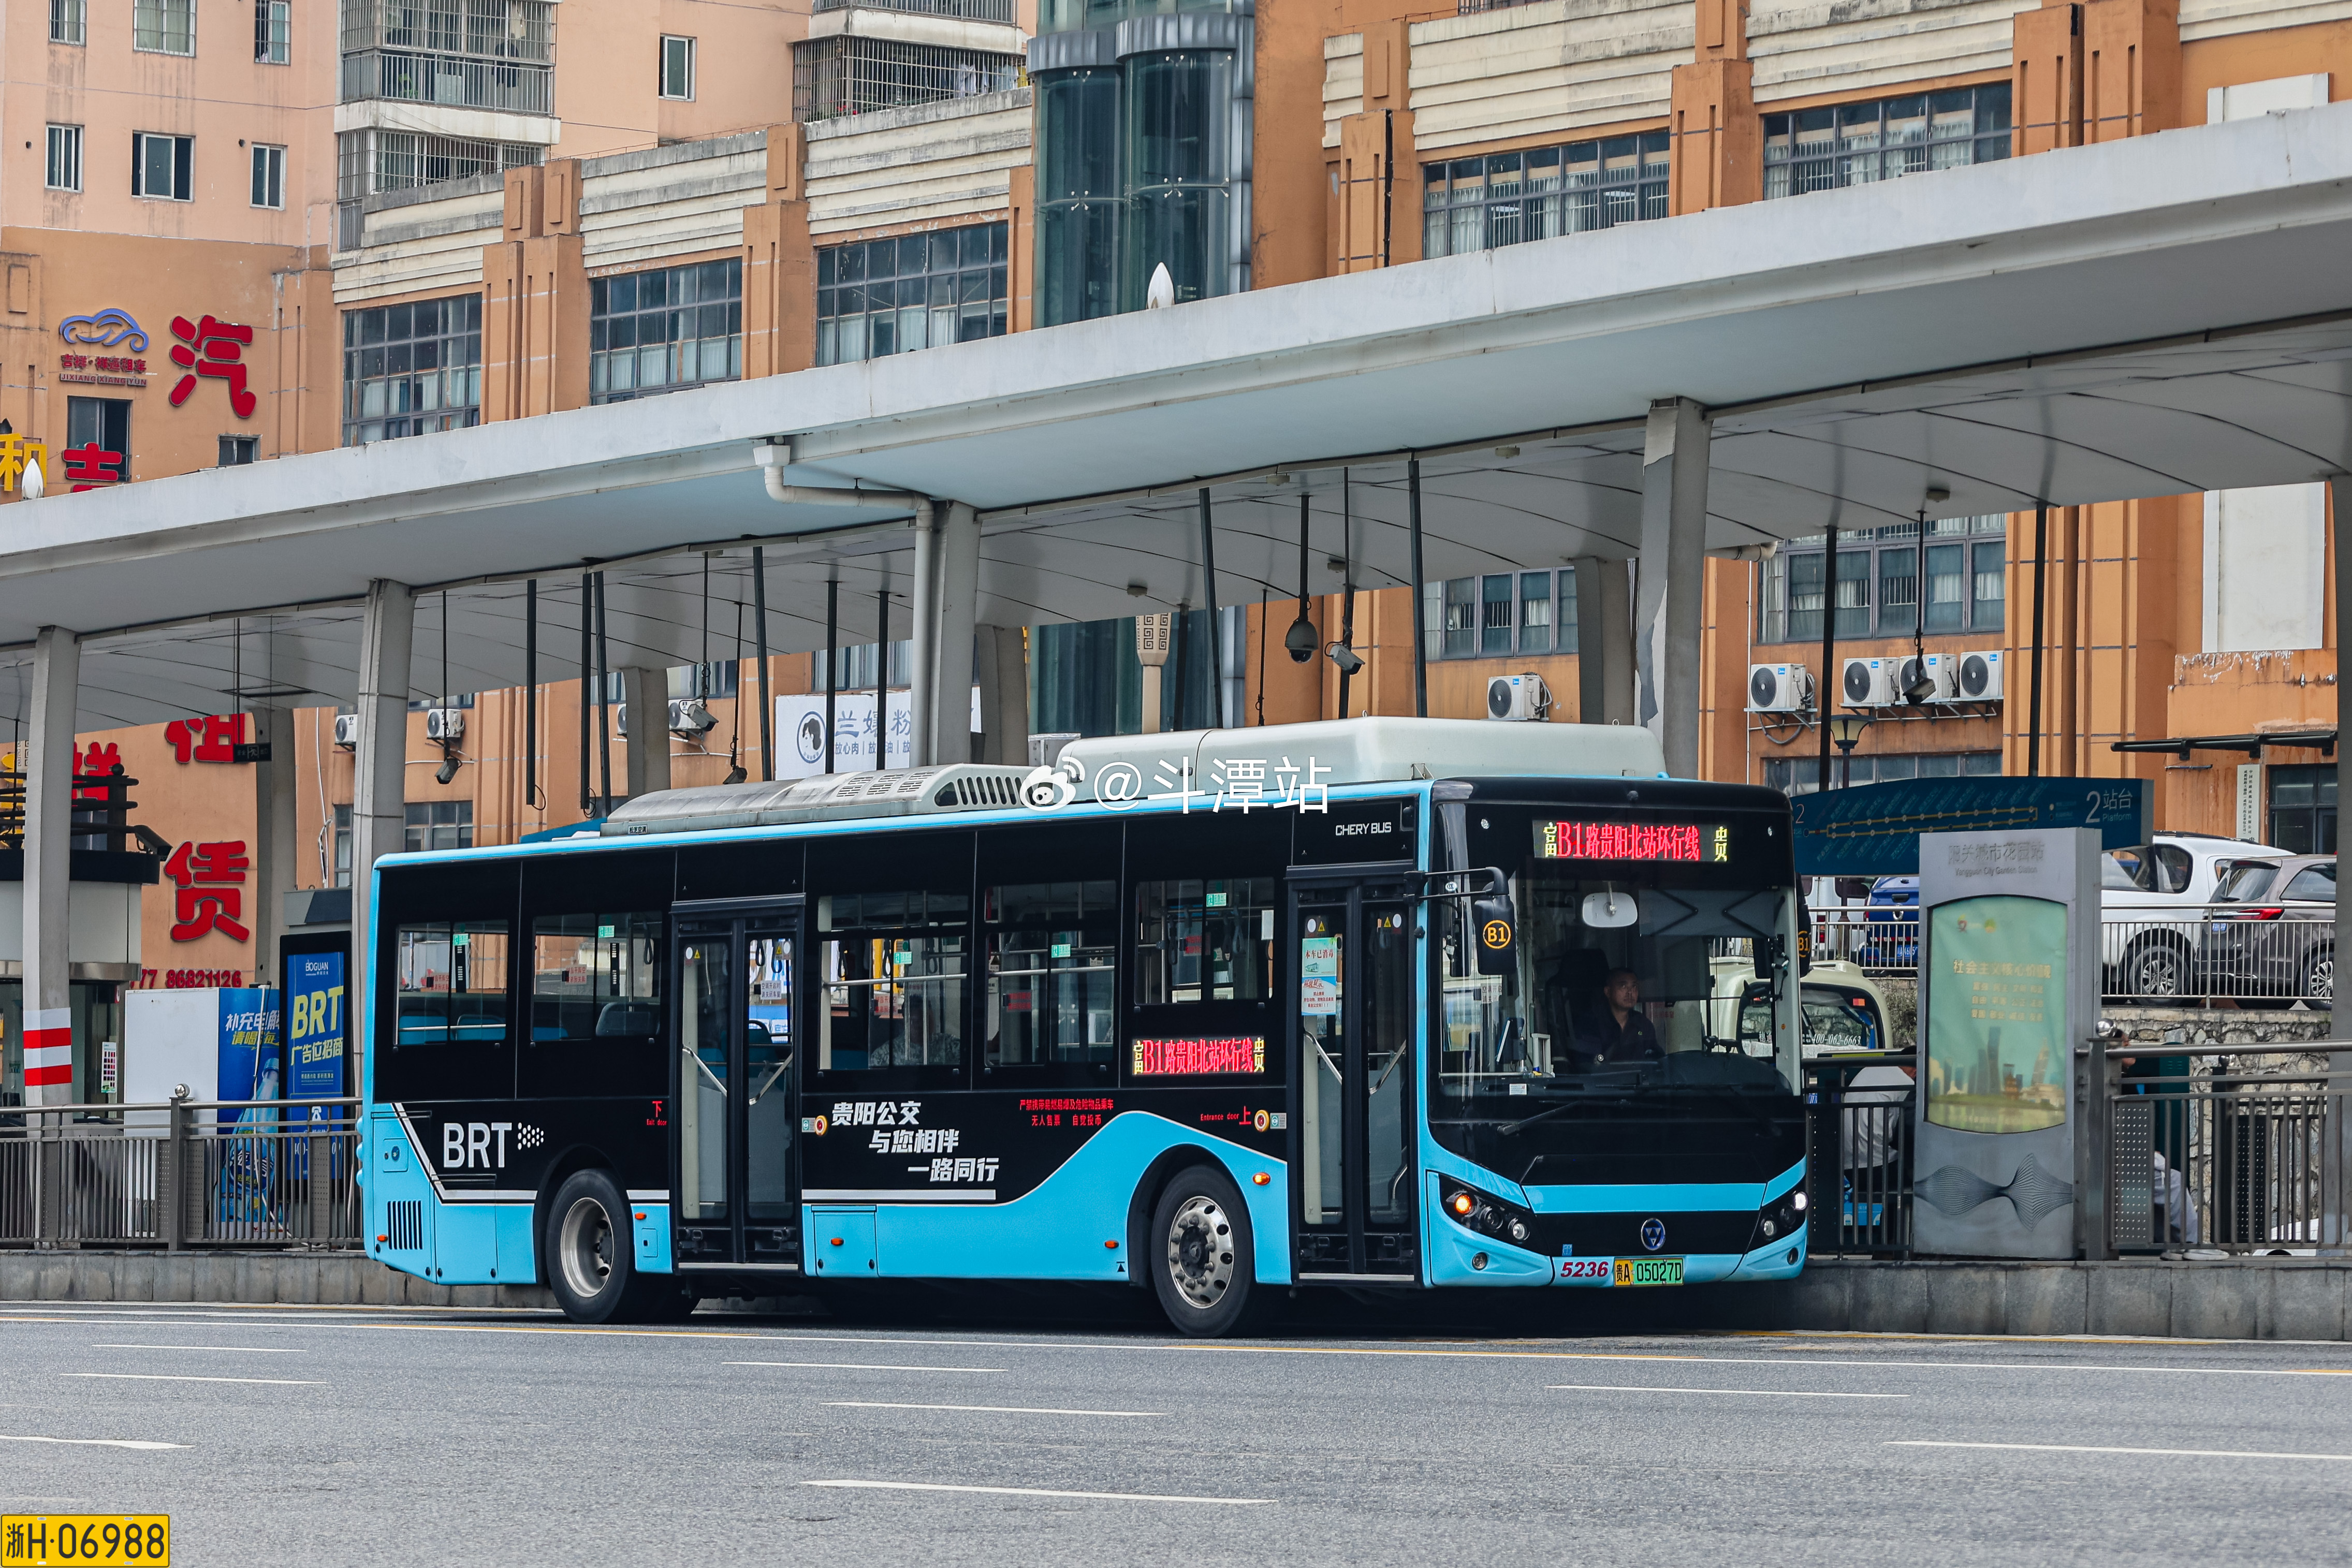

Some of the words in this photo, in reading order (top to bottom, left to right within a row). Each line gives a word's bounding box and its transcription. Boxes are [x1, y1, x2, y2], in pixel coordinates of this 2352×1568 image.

[62, 373, 96, 382] JIXIANG
[99, 376, 126, 384] XIANG
[835, 742, 859, 755] 放心肉
[2085, 791, 2101, 823] 2
[2103, 788, 2132, 810] 站台
[2102, 813, 2132, 822] Platform
[1336, 823, 1369, 836] CHERY
[1371, 822, 1392, 833] BUS
[1955, 868, 1982, 877] Yangguan
[1984, 867, 1994, 876] City
[1487, 927, 1507, 942] B1
[1799, 937, 1809, 951] B1
[1305, 949, 1334, 959] 本车已消毒
[305, 961, 328, 971] BOGUAN
[166, 969, 242, 988] 86821126
[291, 986, 344, 1039] BRT
[1812, 1033, 1861, 1046] 400-062-6663
[291, 1037, 343, 1066] 广告位招商
[652, 1101, 662, 1118] 下
[1019, 1098, 1114, 1110] 严禁携带易燃易爆及危险物品乘车
[831, 1101, 922, 1126] 贵阳公交
[1032, 1114, 1060, 1126] 无人售票
[1073, 1114, 1101, 1126] 自觉投币
[1201, 1113, 1223, 1121] Entrance
[1239, 1106, 1251, 1125] 上
[444, 1122, 512, 1168] BRT
[869, 1129, 959, 1153] 与您相伴
[908, 1157, 999, 1182] 一路同行
[1560, 1261, 1609, 1278] 5236
